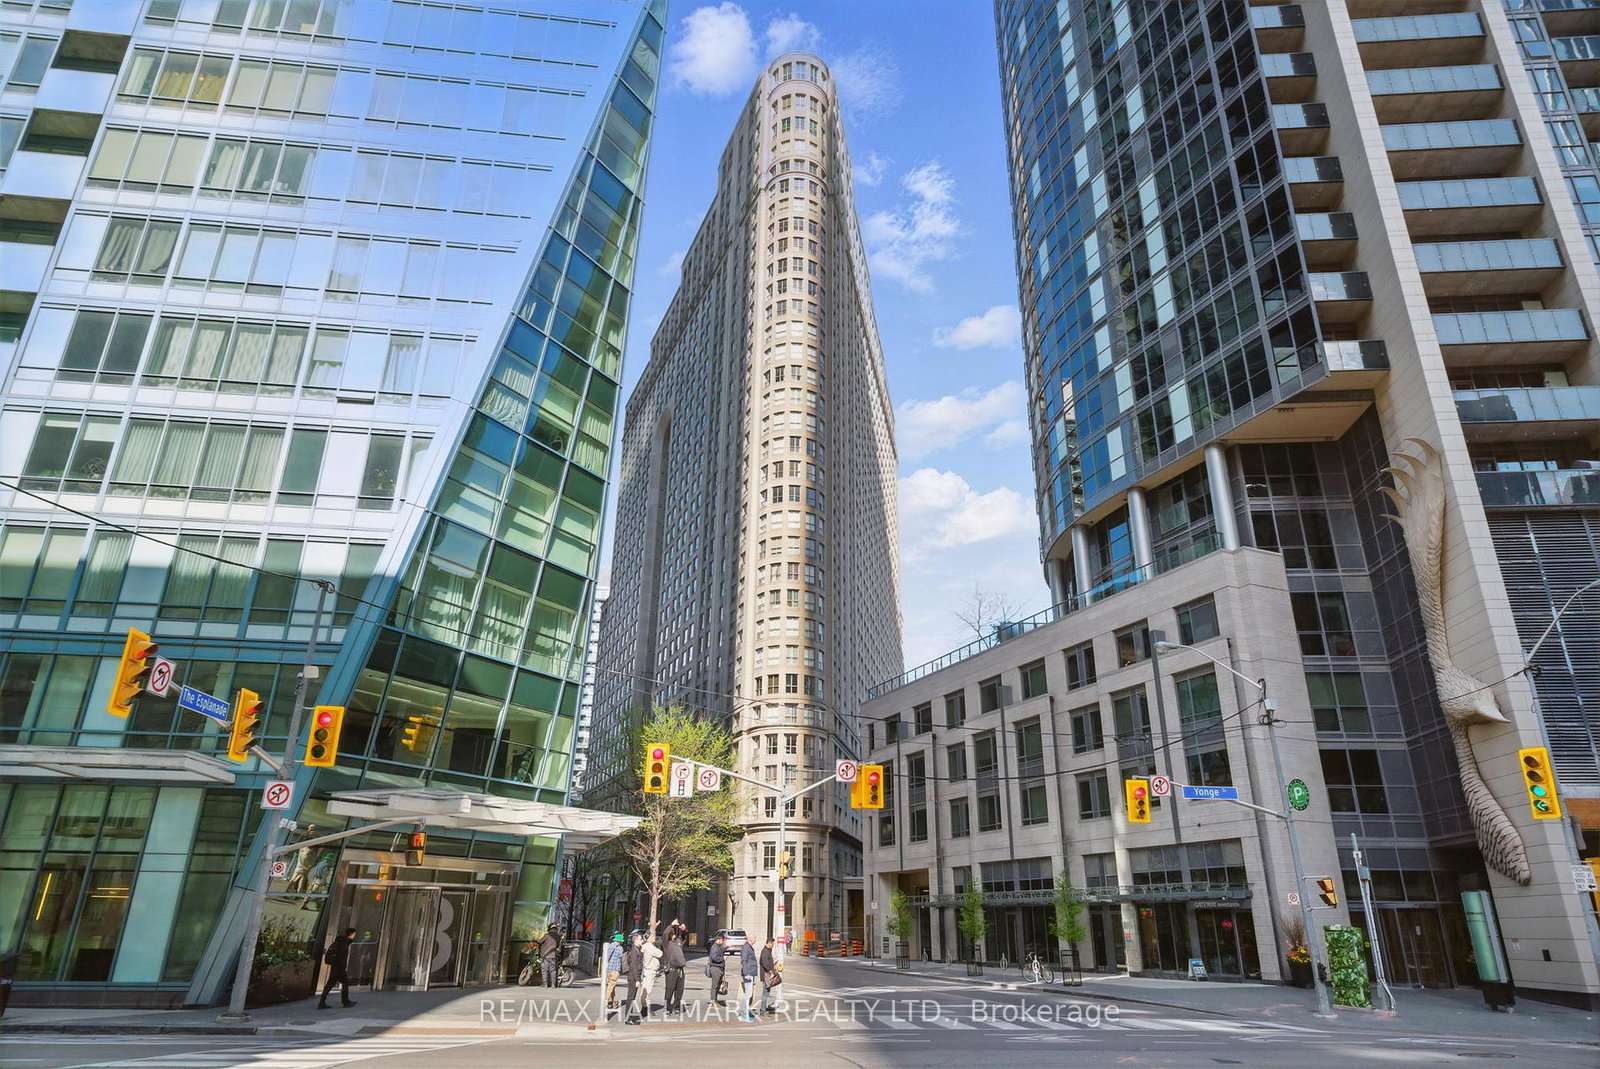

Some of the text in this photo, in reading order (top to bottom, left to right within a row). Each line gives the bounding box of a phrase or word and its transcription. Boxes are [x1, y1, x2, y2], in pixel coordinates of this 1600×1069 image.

[183, 688, 227, 716] The Esplanade
[1194, 787, 1219, 798] Yonge
[1294, 787, 1302, 800] P
